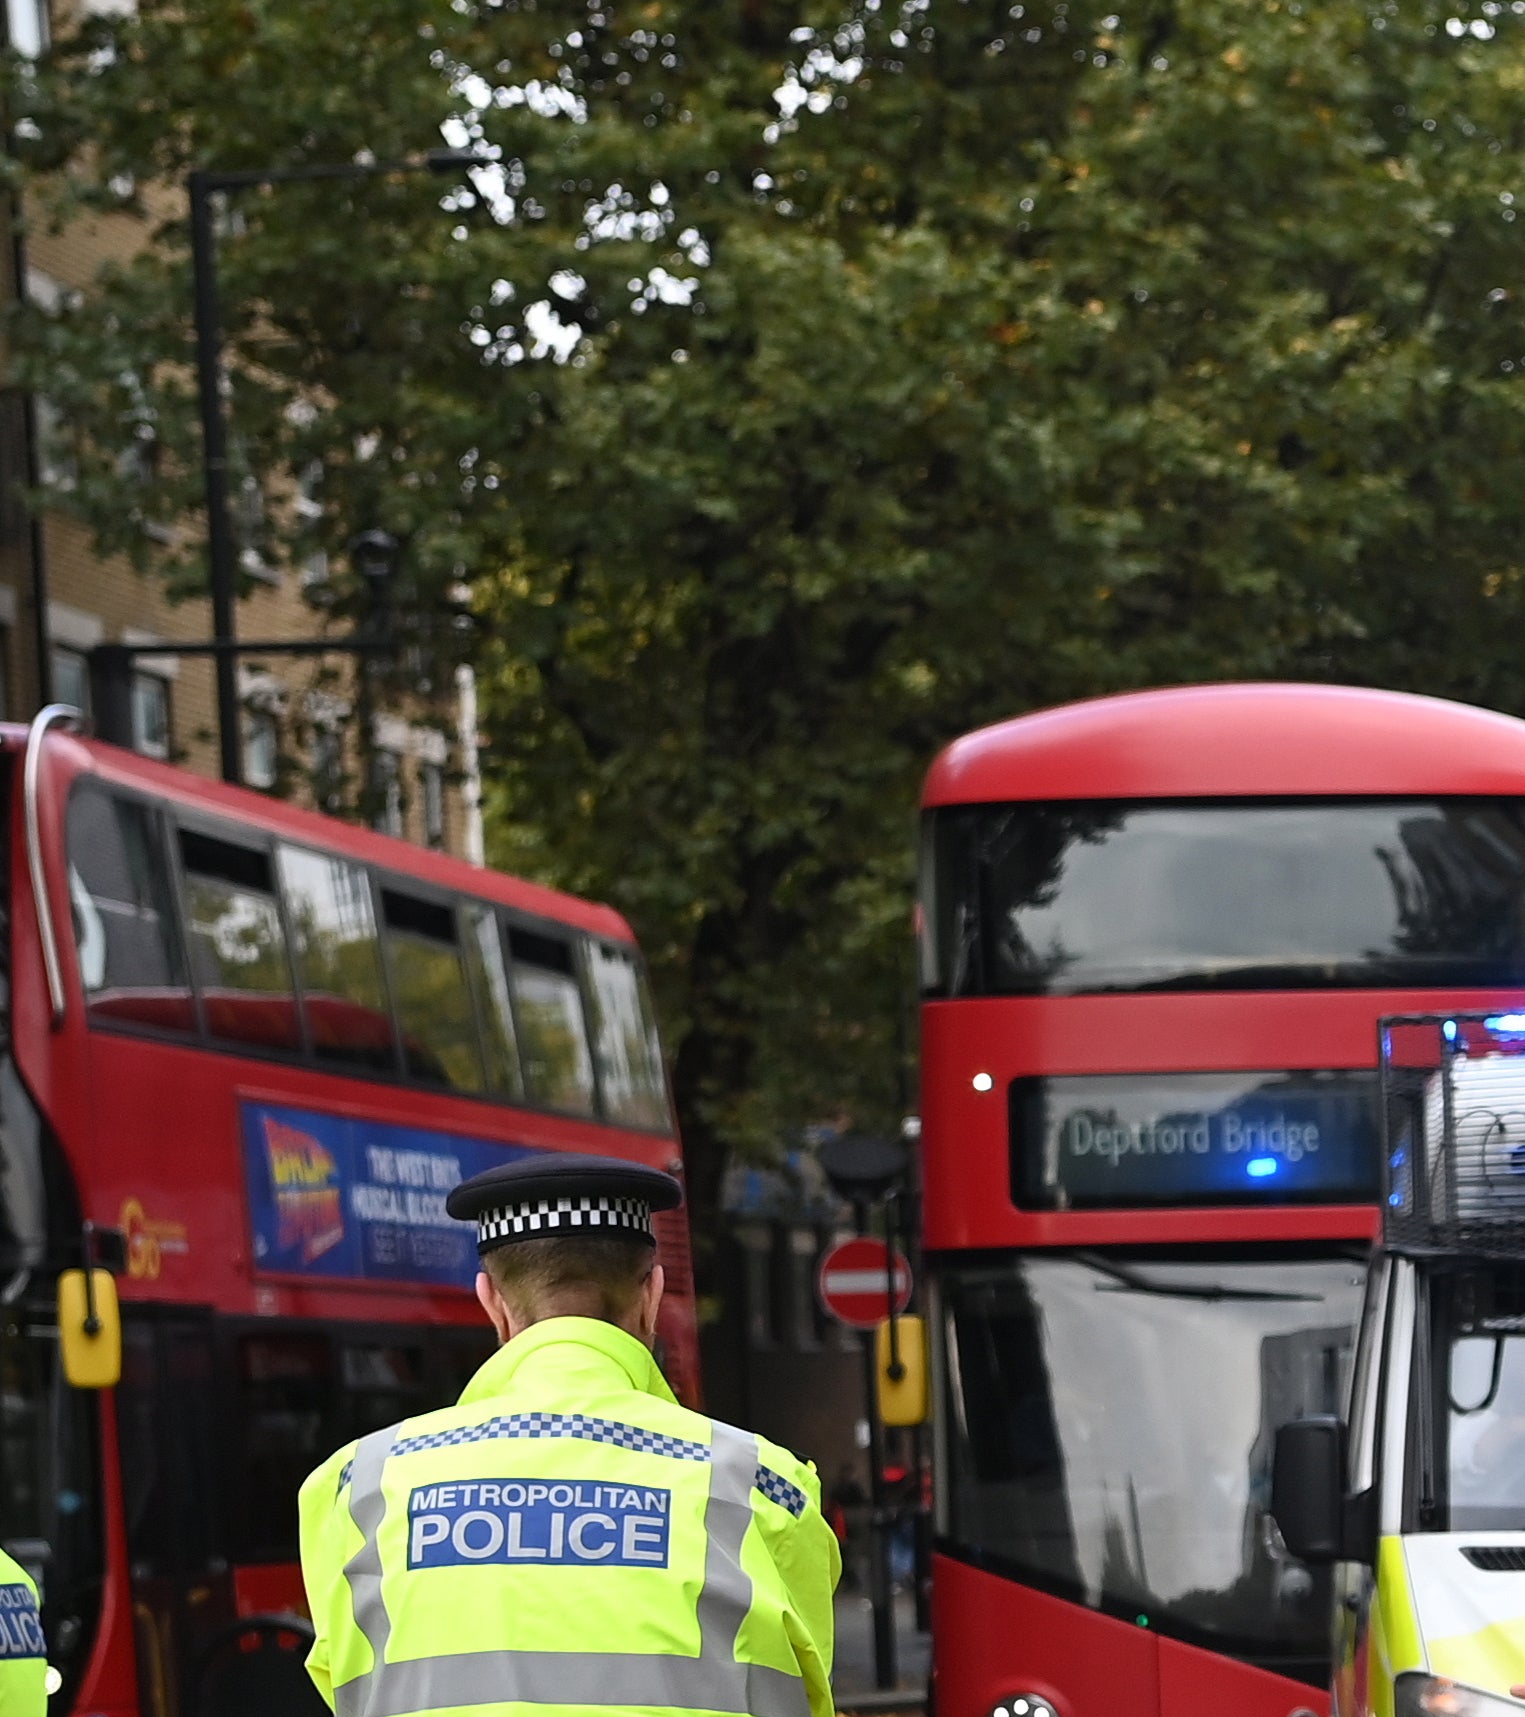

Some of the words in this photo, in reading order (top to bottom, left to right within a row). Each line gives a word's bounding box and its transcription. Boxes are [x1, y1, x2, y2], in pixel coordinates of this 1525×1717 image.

[1069, 1113, 1210, 1167] Deptford
[1220, 1113, 1320, 1162] Bridge
[412, 1483, 667, 1513] METROPOLITAN
[411, 1510, 664, 1563] POLICE
